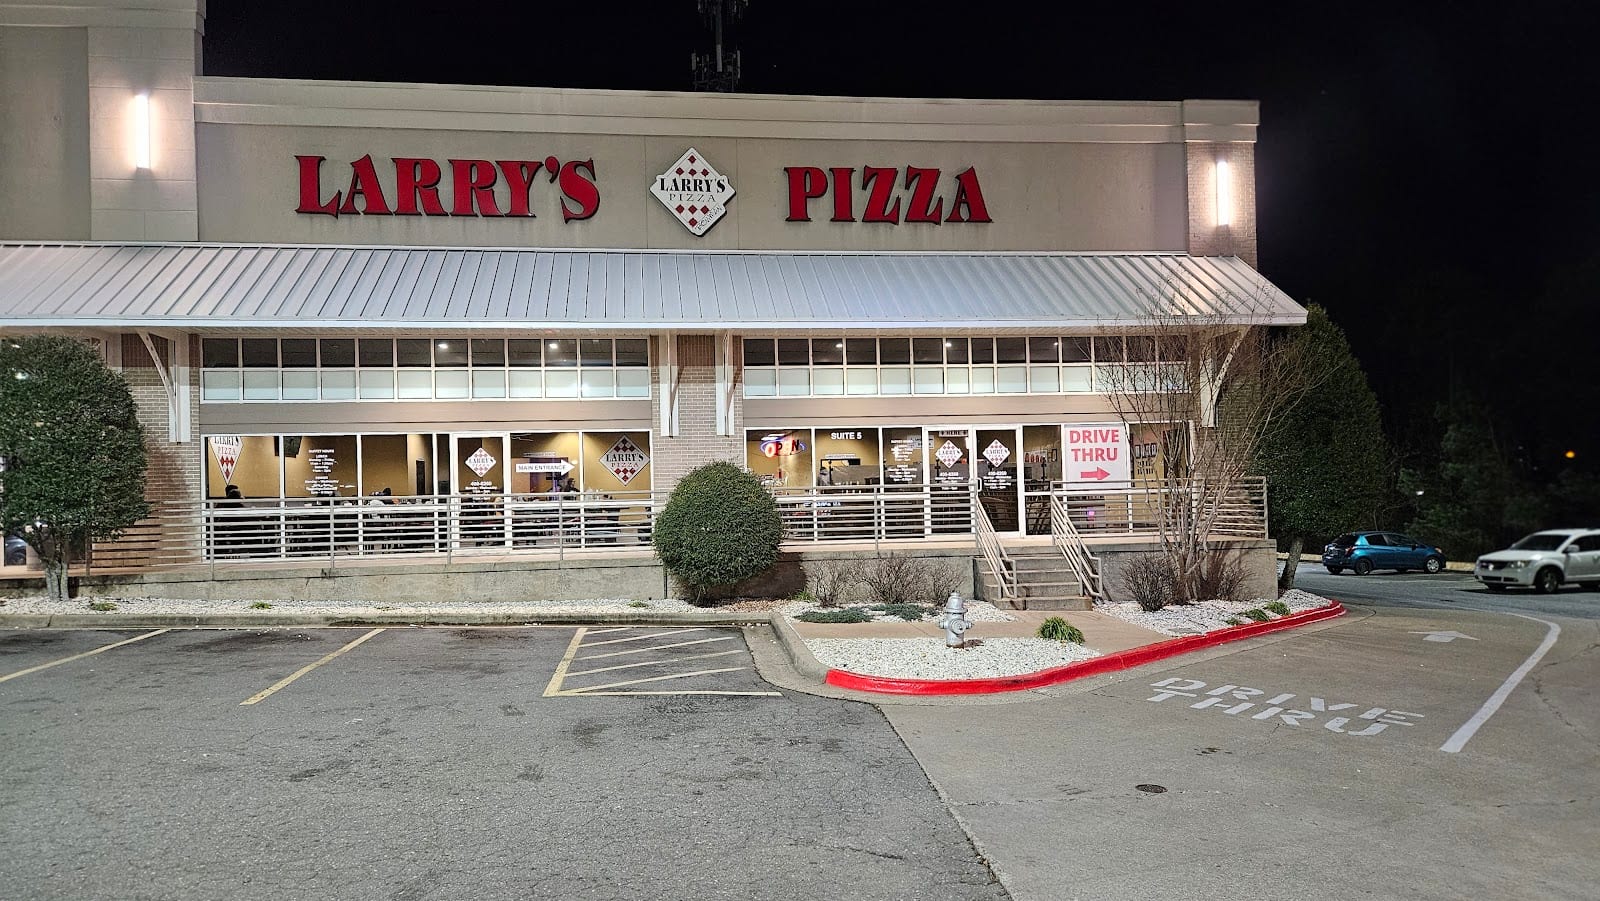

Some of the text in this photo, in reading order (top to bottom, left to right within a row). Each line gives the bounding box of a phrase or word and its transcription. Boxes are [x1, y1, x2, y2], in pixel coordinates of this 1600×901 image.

[294, 153, 601, 225] LARRY'S
[783, 165, 993, 226] PIZZA
[659, 177, 726, 194] LARRY'S
[669, 193, 717, 203] PIZZA
[830, 432, 863, 440] SUITE 5
[1069, 429, 1120, 444] DRIVE
[606, 453, 645, 463] LARRY'S
[1070, 447, 1118, 462] THRU
[1149, 677, 1425, 727] DRIVE
[1145, 687, 1391, 737] THRU
